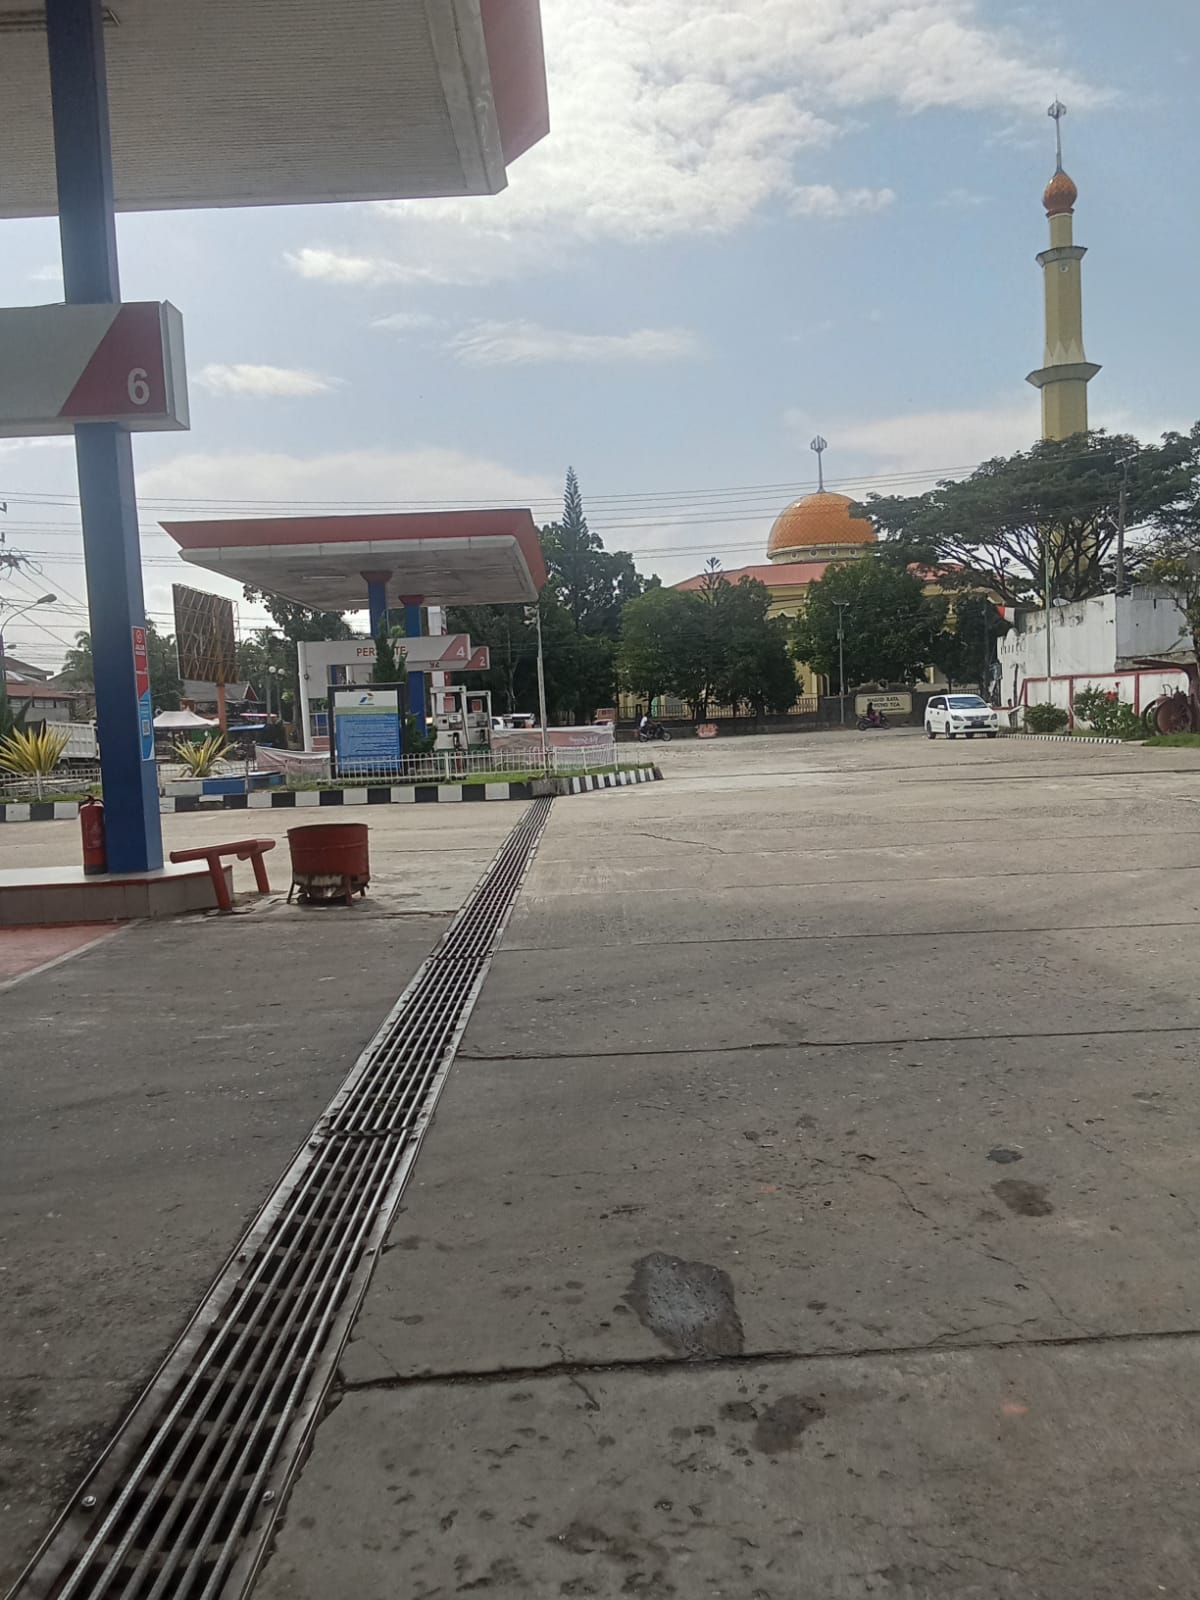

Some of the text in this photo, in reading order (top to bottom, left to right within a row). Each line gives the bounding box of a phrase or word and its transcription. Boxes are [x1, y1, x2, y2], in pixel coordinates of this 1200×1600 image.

[128, 367, 150, 405] 6
[356, 646, 407, 657] PERTE
[457, 647, 465, 657] 4
[480, 656, 486, 666] 2
